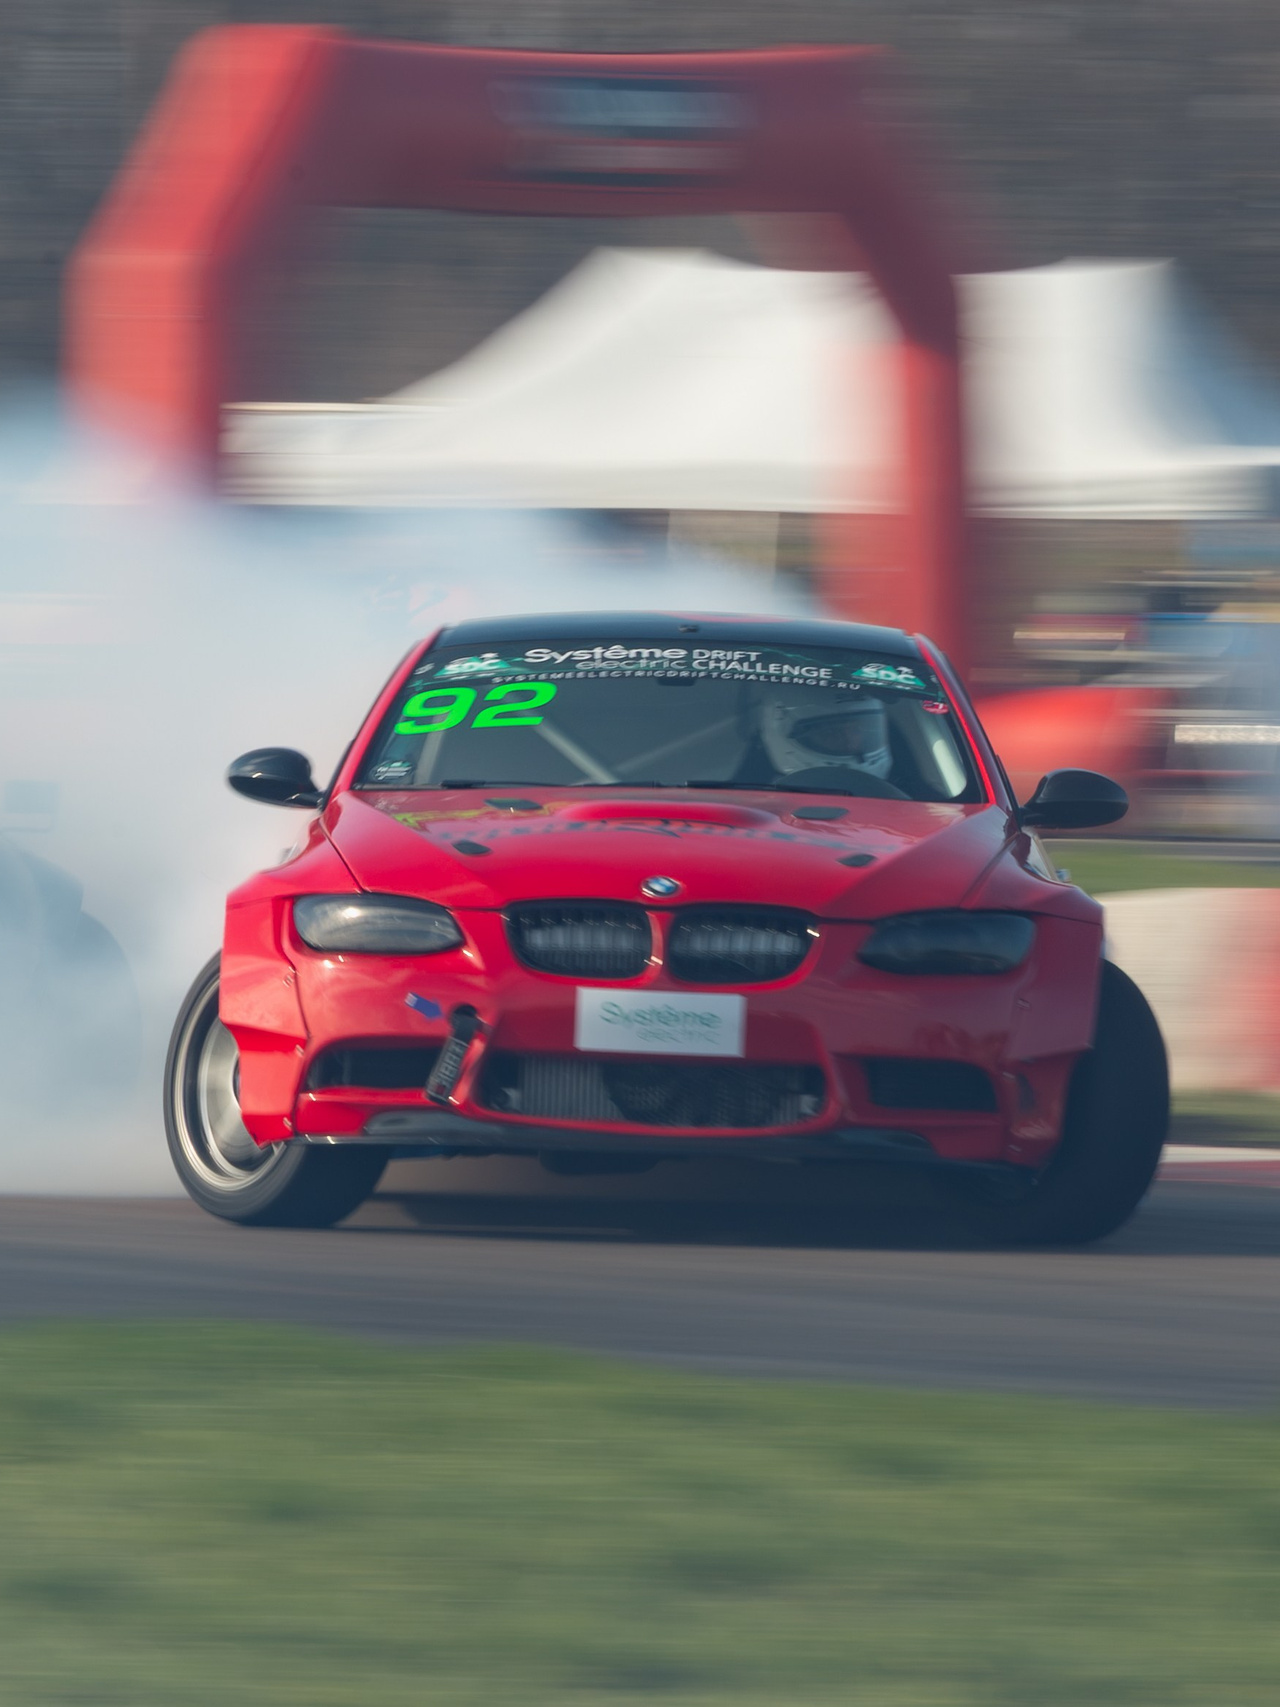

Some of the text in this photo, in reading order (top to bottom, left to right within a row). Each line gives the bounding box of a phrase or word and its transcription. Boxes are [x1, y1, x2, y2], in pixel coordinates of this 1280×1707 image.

[693, 649, 761, 661] DRIFT
[575, 659, 833, 679] electric CHALLENGE
[860, 667, 918, 685] SDC
[394, 682, 558, 735] 92
